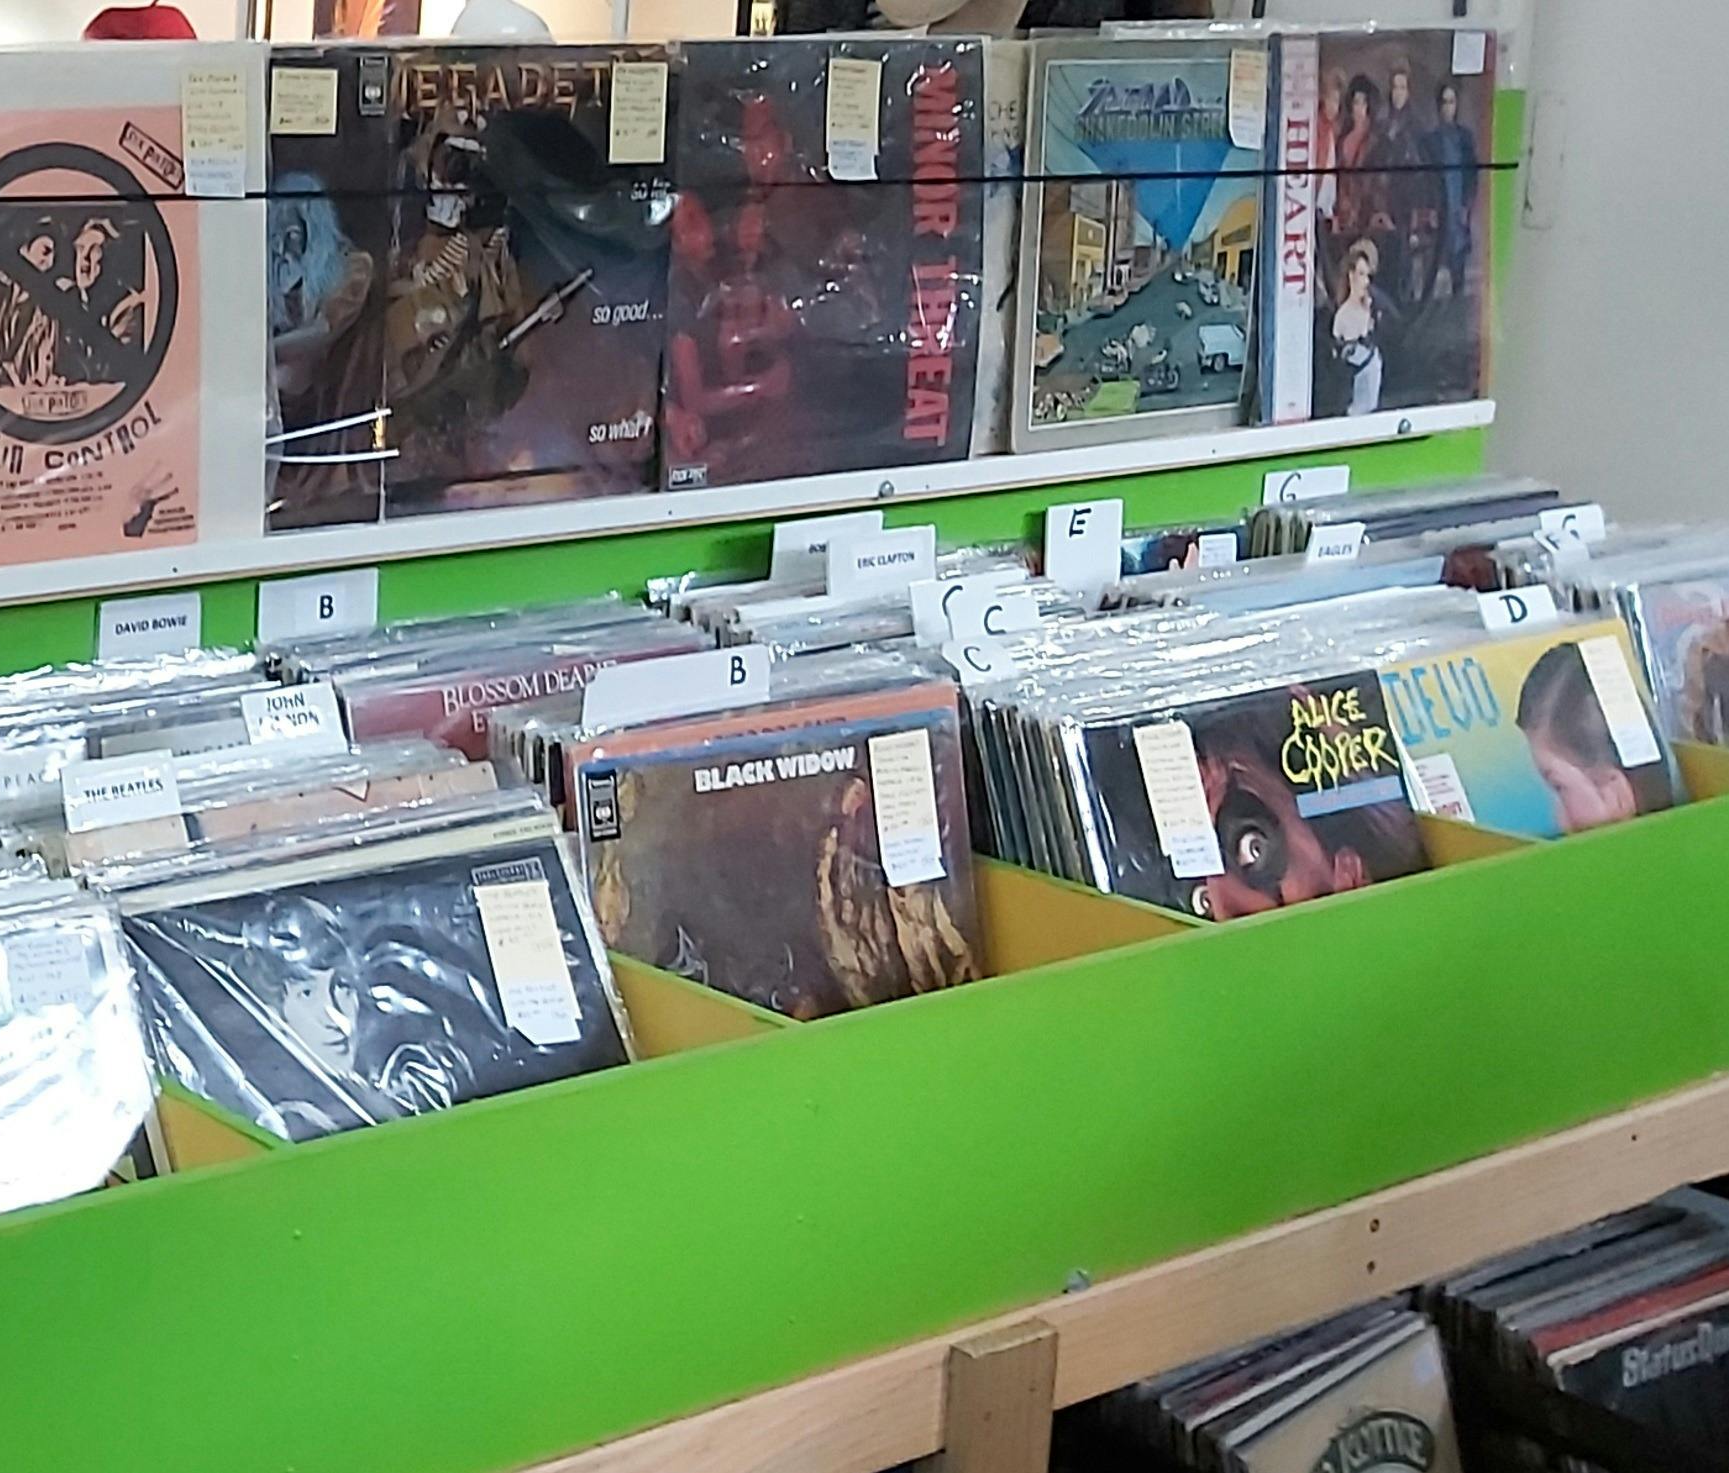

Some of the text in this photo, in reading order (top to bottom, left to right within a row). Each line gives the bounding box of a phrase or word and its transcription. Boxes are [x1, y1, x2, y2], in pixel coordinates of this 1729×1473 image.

[911, 66, 960, 237] MINOR
[1283, 116, 1310, 295] HEART
[1068, 507, 1092, 537] E
[857, 551, 915, 569] ERIC CLAPTON
[319, 594, 334, 620] B
[983, 604, 1006, 636] C
[1498, 594, 1528, 623] D
[114, 614, 188, 636] DAVID BOWIE
[729, 655, 747, 686] B
[963, 645, 992, 673] C
[265, 691, 306, 713] JOHN
[441, 673, 540, 718] BLOSSOM
[1291, 686, 1368, 734] ALICE
[1381, 657, 1501, 747] DEVO
[693, 746, 856, 793] BLACK WIDOW
[1281, 727, 1400, 794] COOPER
[83, 778, 165, 803] THE BEATLES
